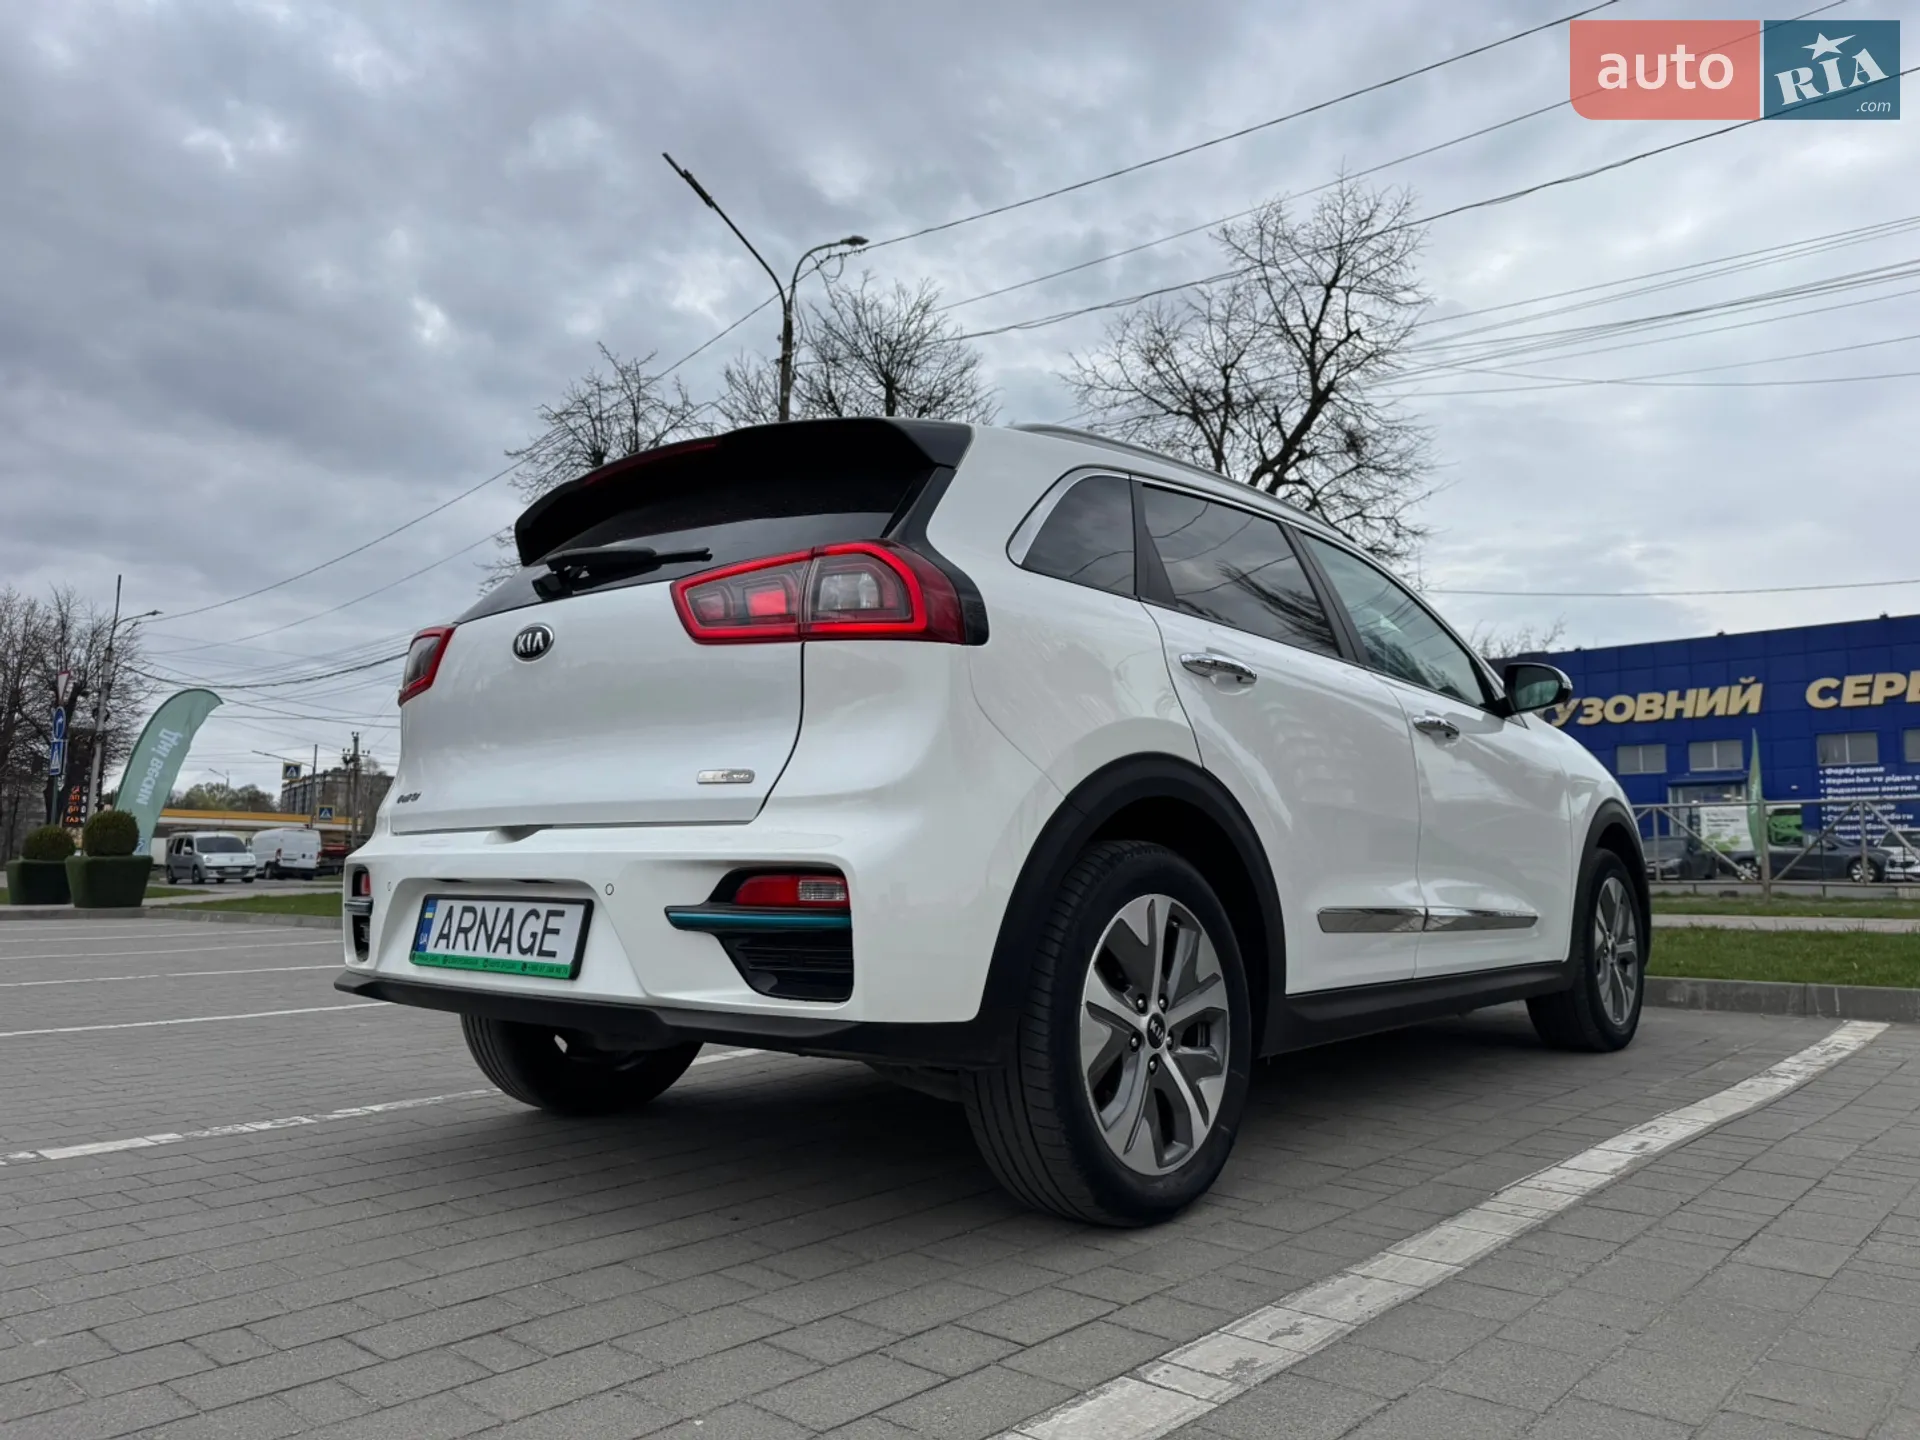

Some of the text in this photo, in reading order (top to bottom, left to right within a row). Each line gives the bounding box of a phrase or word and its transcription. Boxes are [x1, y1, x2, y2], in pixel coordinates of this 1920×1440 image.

[517, 631, 545, 654] KIA
[1536, 677, 1763, 727] УЗОВНИЙ
[434, 905, 565, 958] ARNAGE
